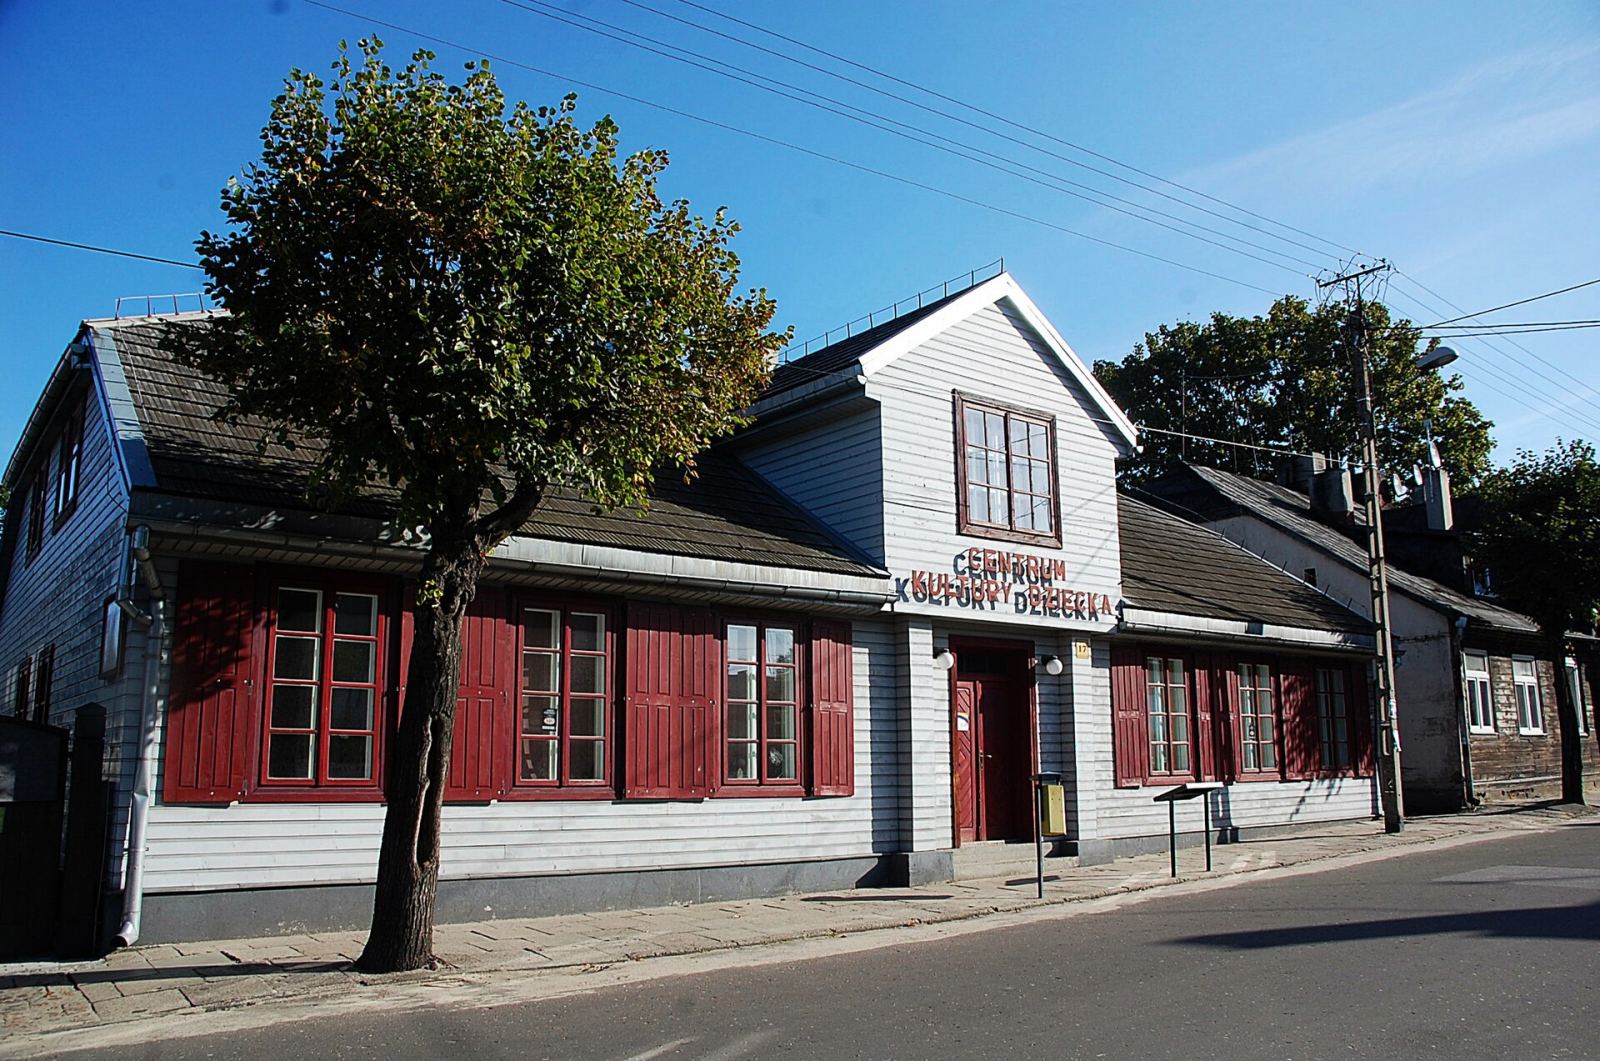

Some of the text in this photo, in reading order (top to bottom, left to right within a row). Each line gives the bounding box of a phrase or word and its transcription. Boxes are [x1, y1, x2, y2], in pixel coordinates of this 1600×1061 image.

[967, 547, 1066, 581] CENTRUM
[911, 569, 1112, 615] KULTURY DZIECKA
[1078, 644, 1087, 653] 17
